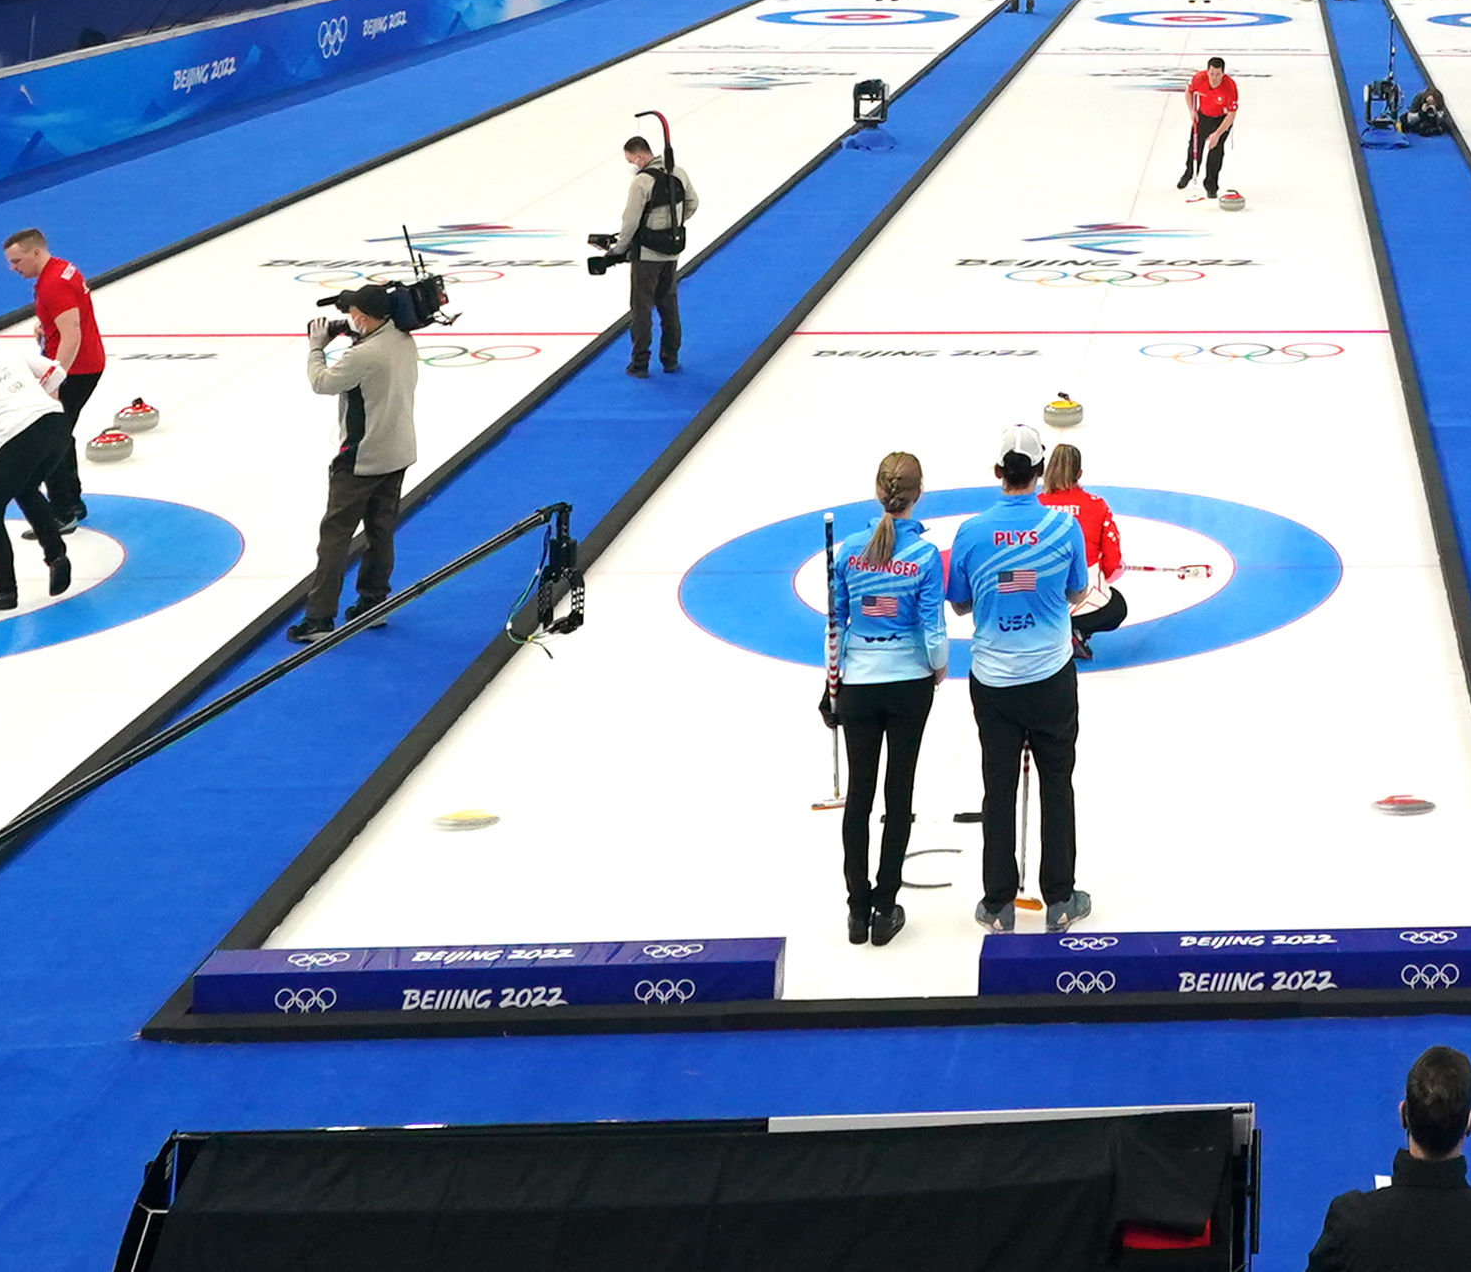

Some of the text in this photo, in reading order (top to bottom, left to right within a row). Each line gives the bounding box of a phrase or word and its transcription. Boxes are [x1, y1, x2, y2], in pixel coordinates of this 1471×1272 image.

[173, 57, 236, 93] BEIJING 2022
[956, 259, 1123, 268] BEIJING
[994, 532, 1038, 546] PLYS
[848, 556, 918, 577] PERSINGER
[999, 614, 1036, 632] USA
[1180, 934, 1337, 948] BEIJING 2022
[411, 948, 575, 964] BEIJING 2022
[1179, 970, 1337, 992] BEIJING 2022
[402, 987, 568, 1010] BEIJING 2022
